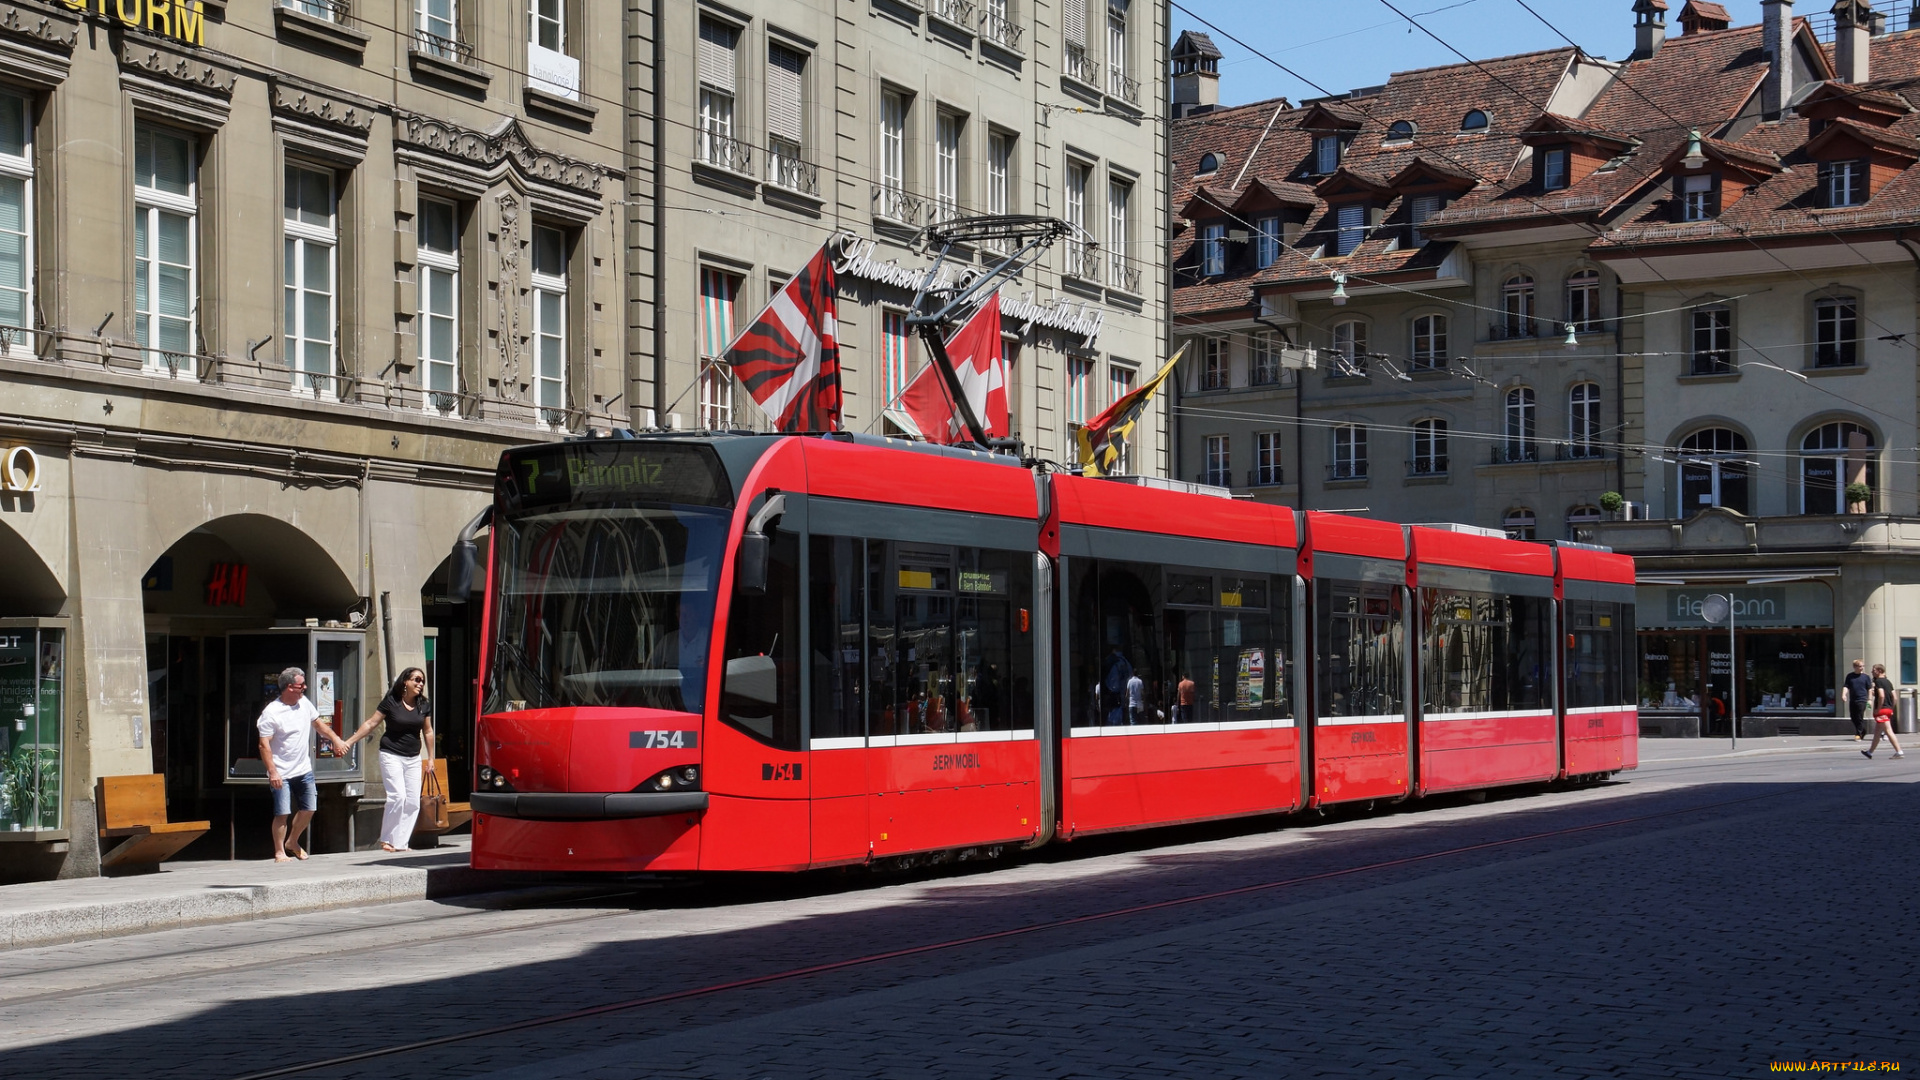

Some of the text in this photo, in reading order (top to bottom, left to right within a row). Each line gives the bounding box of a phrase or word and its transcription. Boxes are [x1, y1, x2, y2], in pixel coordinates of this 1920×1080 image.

[62, 0, 204, 46] URM
[832, 231, 957, 300] Schweizeriche
[521, 456, 663, 494] 7 Bümpliz
[207, 562, 249, 607] H&M
[1677, 594, 1775, 617] fieann
[644, 730, 684, 749] 754
[769, 763, 795, 780] 754
